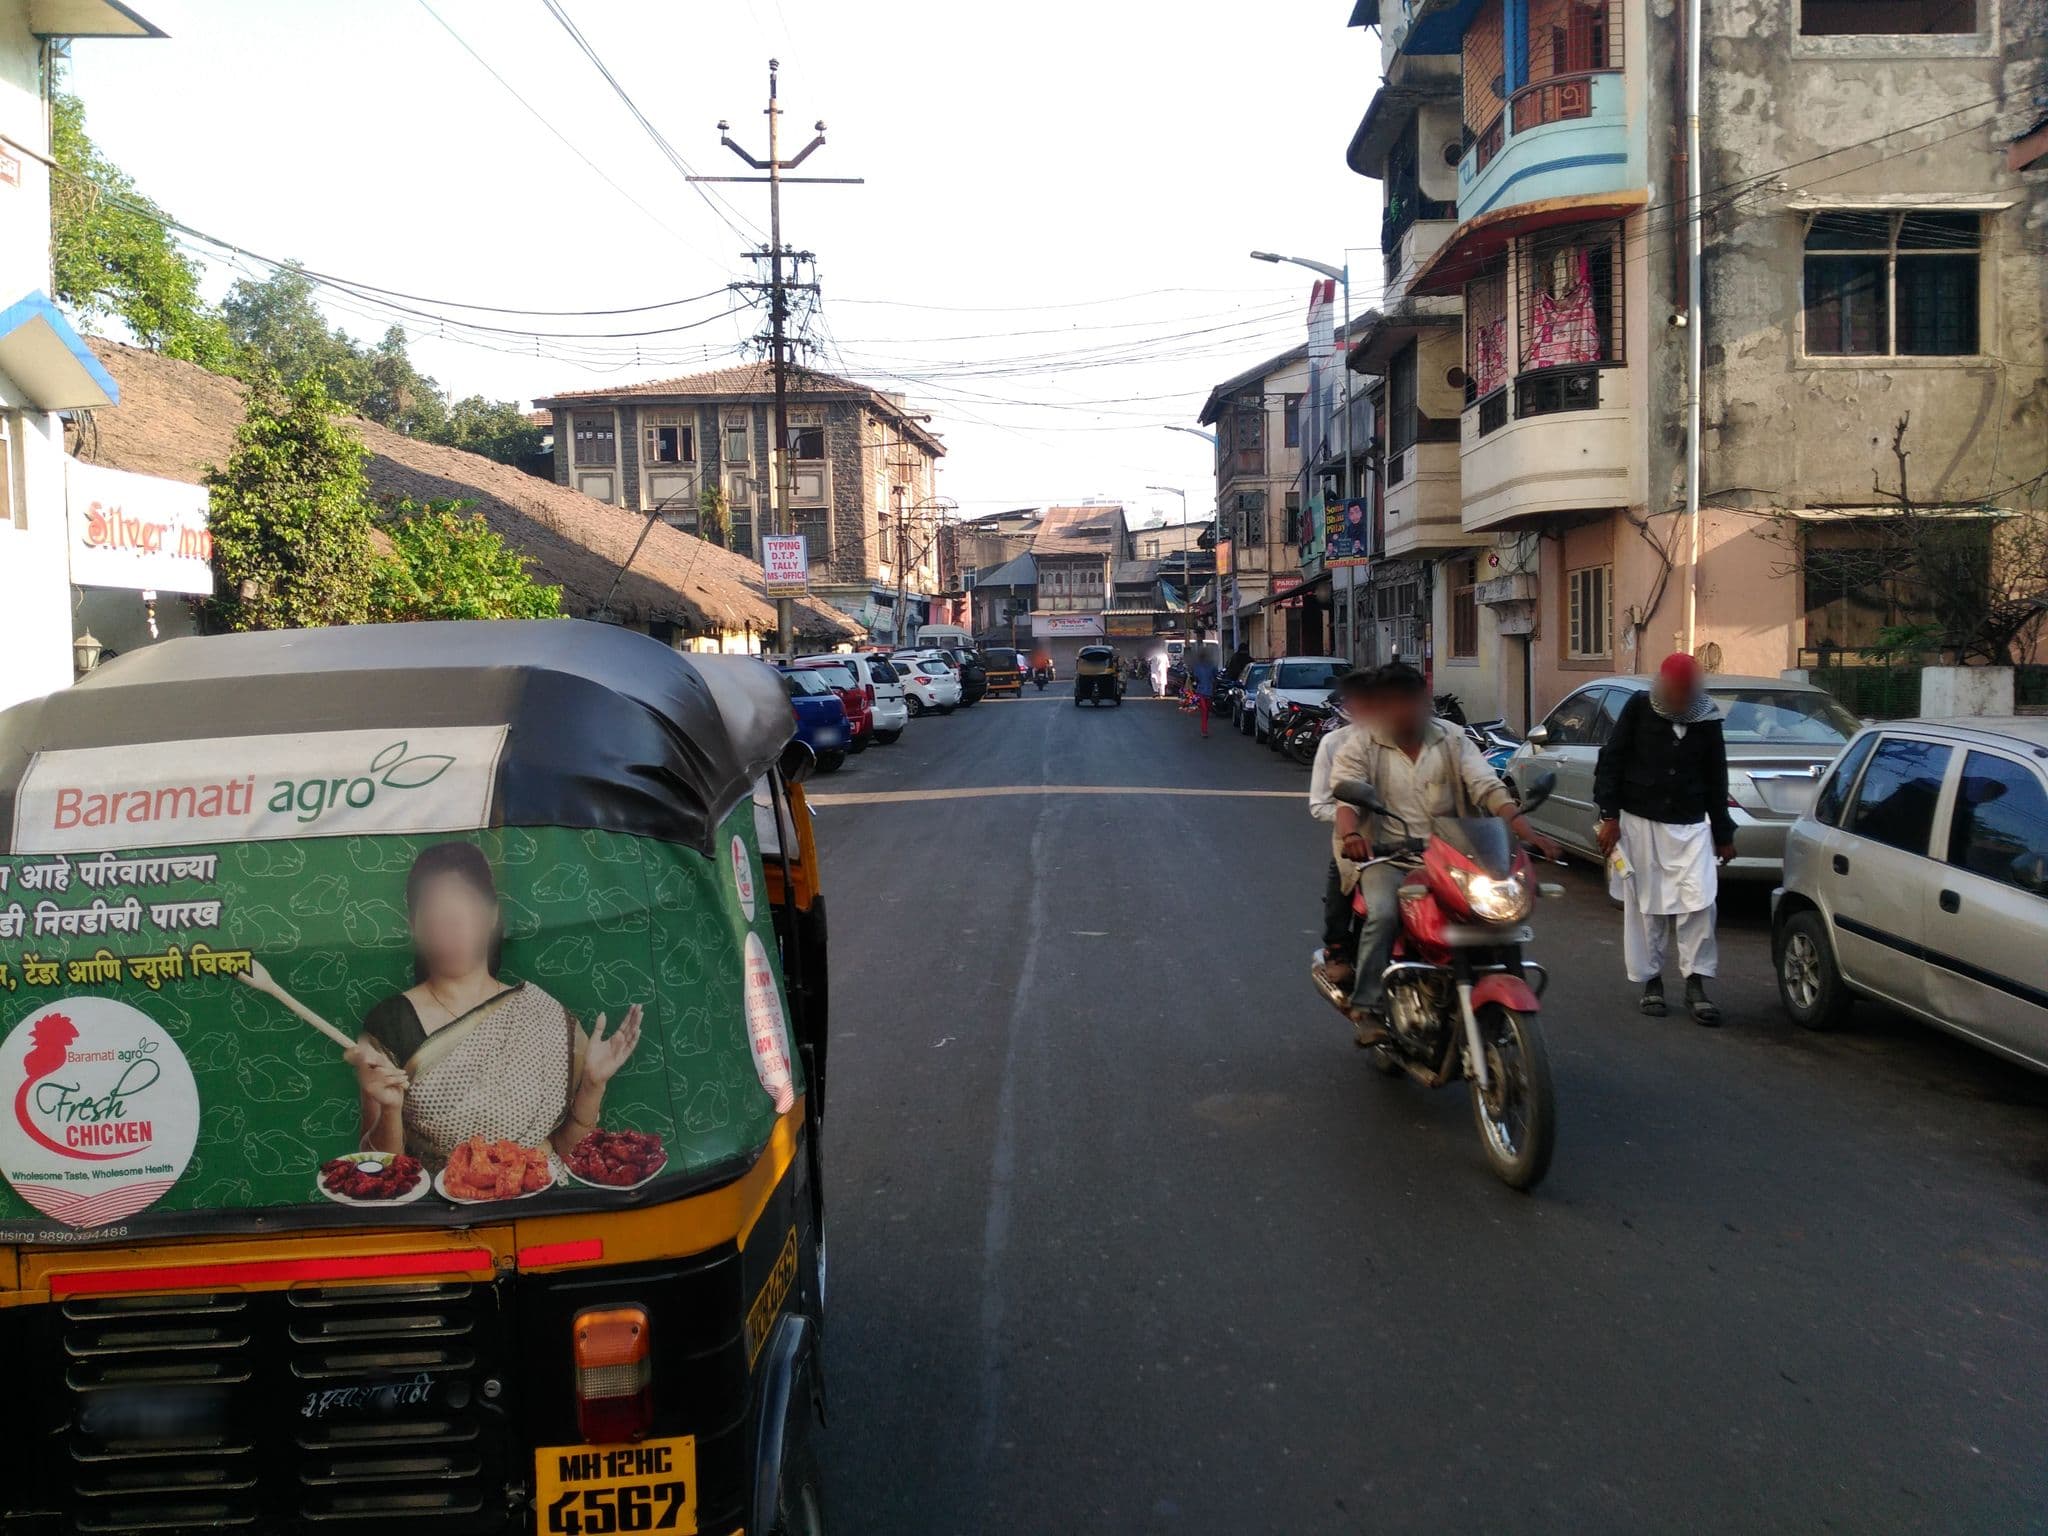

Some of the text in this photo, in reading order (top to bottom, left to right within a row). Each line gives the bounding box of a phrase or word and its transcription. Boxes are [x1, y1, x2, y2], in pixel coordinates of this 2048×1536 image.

[767, 541, 801, 551] TYPING
[771, 552, 798, 560] D.T.P.
[772, 561, 798, 570] TALLY
[53, 775, 376, 830] Baramati agro
[19, 853, 71, 892] आहे
[78, 852, 218, 889] परिवाराच्या
[33, 898, 143, 937] निवडीची
[150, 900, 222, 929] पारख
[22, 953, 61, 986] टेंडर
[67, 949, 122, 982] आणि
[127, 946, 183, 989] ज्युसी
[189, 944, 253, 976] चिकन
[67, 1049, 142, 1063] Baramati agro
[36, 1058, 160, 1122] Fresh
[66, 1120, 153, 1148] CHICKEN
[12, 1164, 174, 1181] Wholesome Taste, Wholesome Health
[559, 1447, 672, 1482] MH12HC
[548, 1481, 686, 1536] 4567
